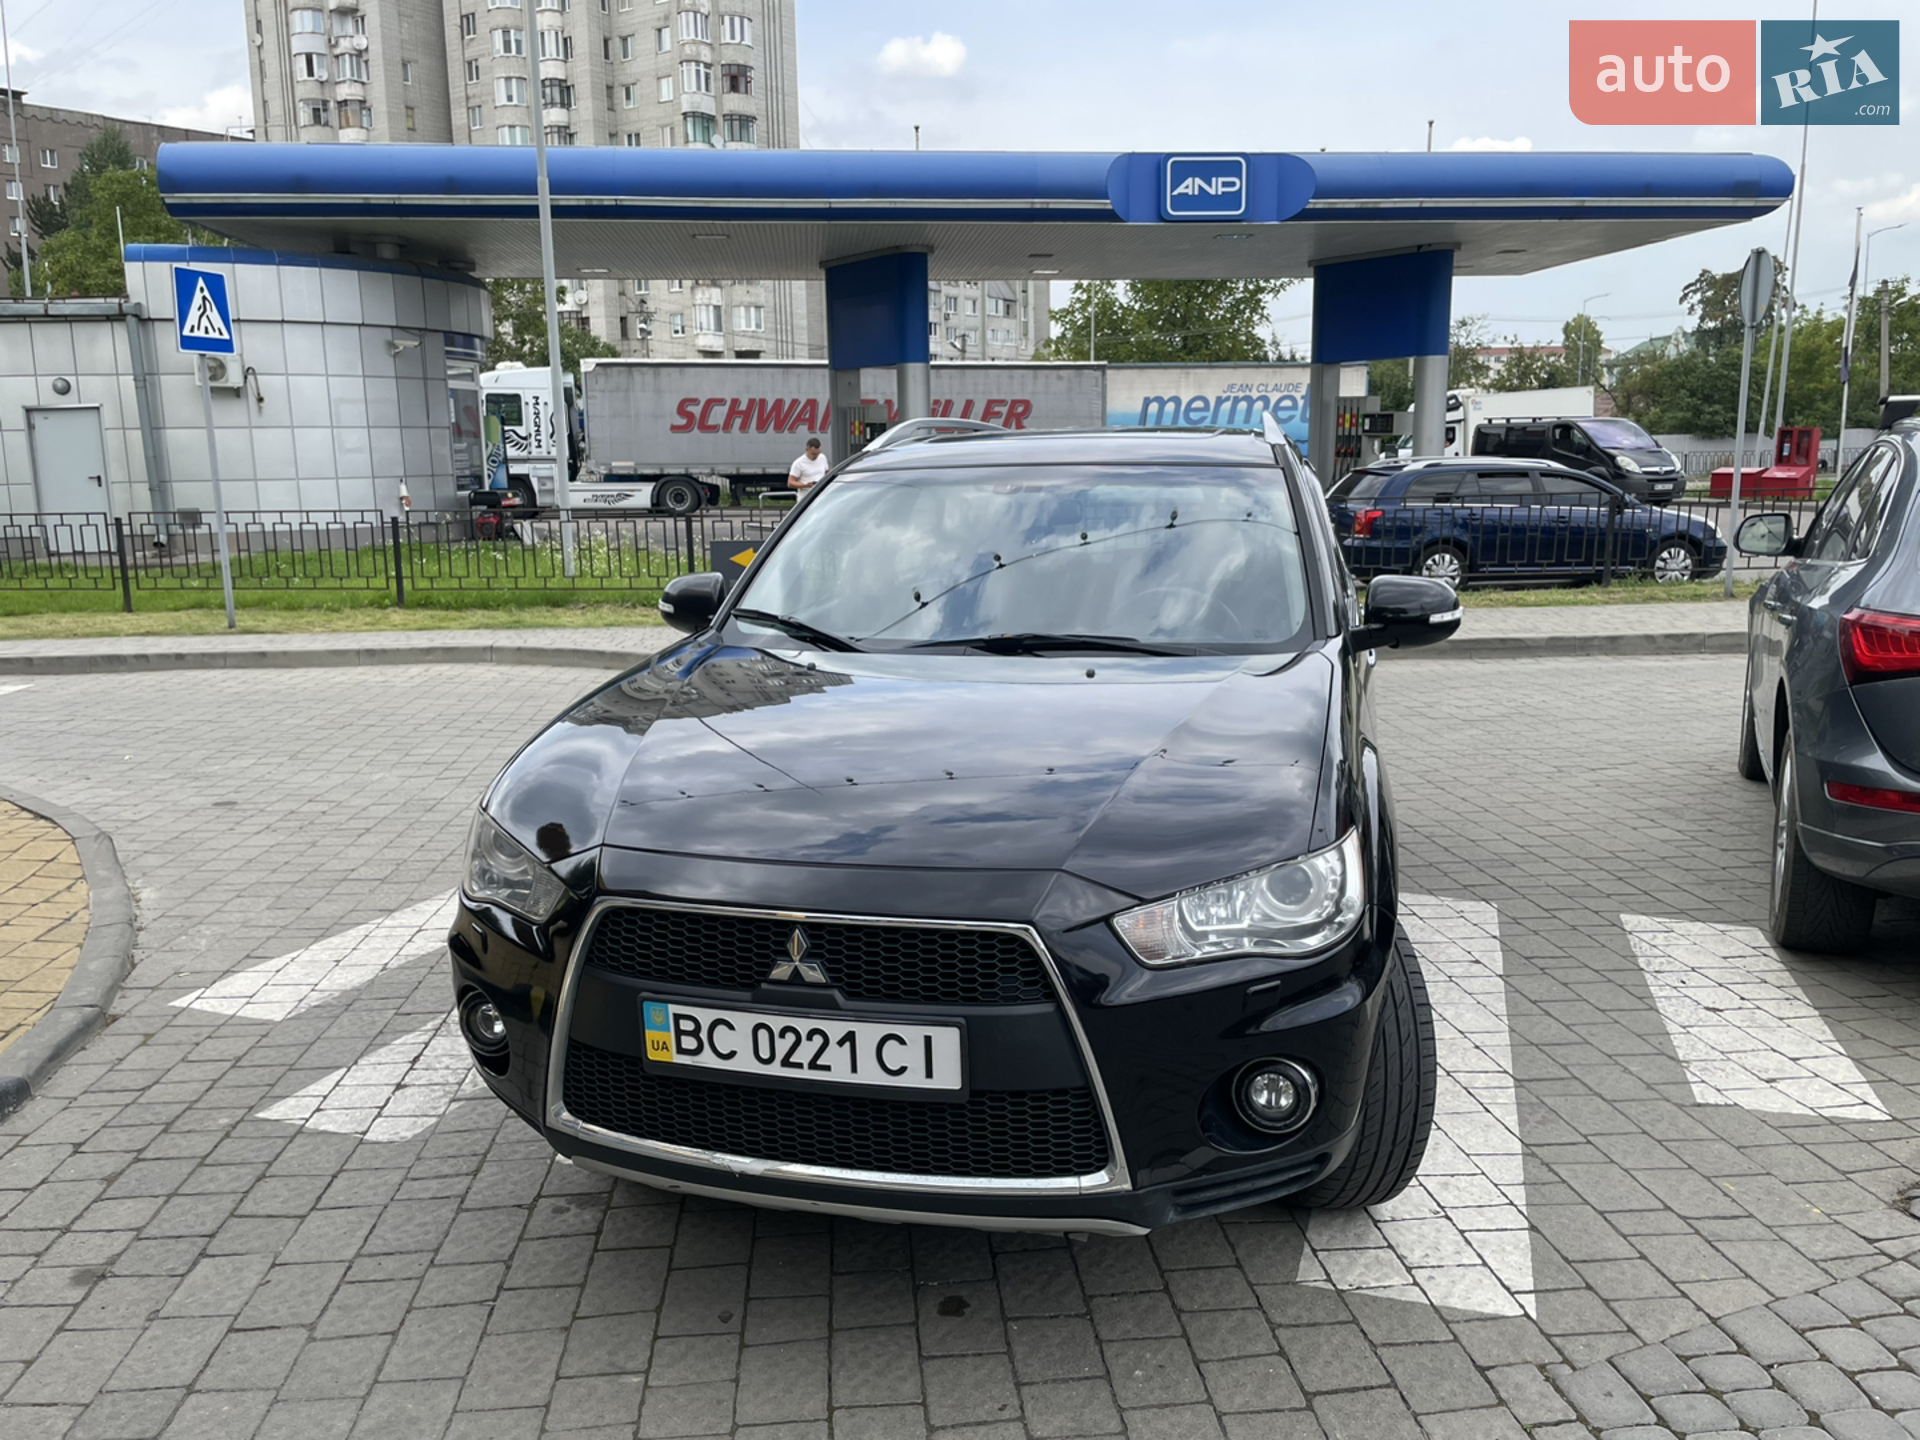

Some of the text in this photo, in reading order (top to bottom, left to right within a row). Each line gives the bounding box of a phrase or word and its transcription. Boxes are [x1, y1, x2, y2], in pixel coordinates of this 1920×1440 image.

[1171, 176, 1241, 196] ANP
[1223, 382, 1303, 394] JEAN CLAUDE
[532, 395, 543, 449] MAGNUM
[651, 1039, 670, 1053] UA
[672, 1012, 934, 1080] BC 0221 CI
